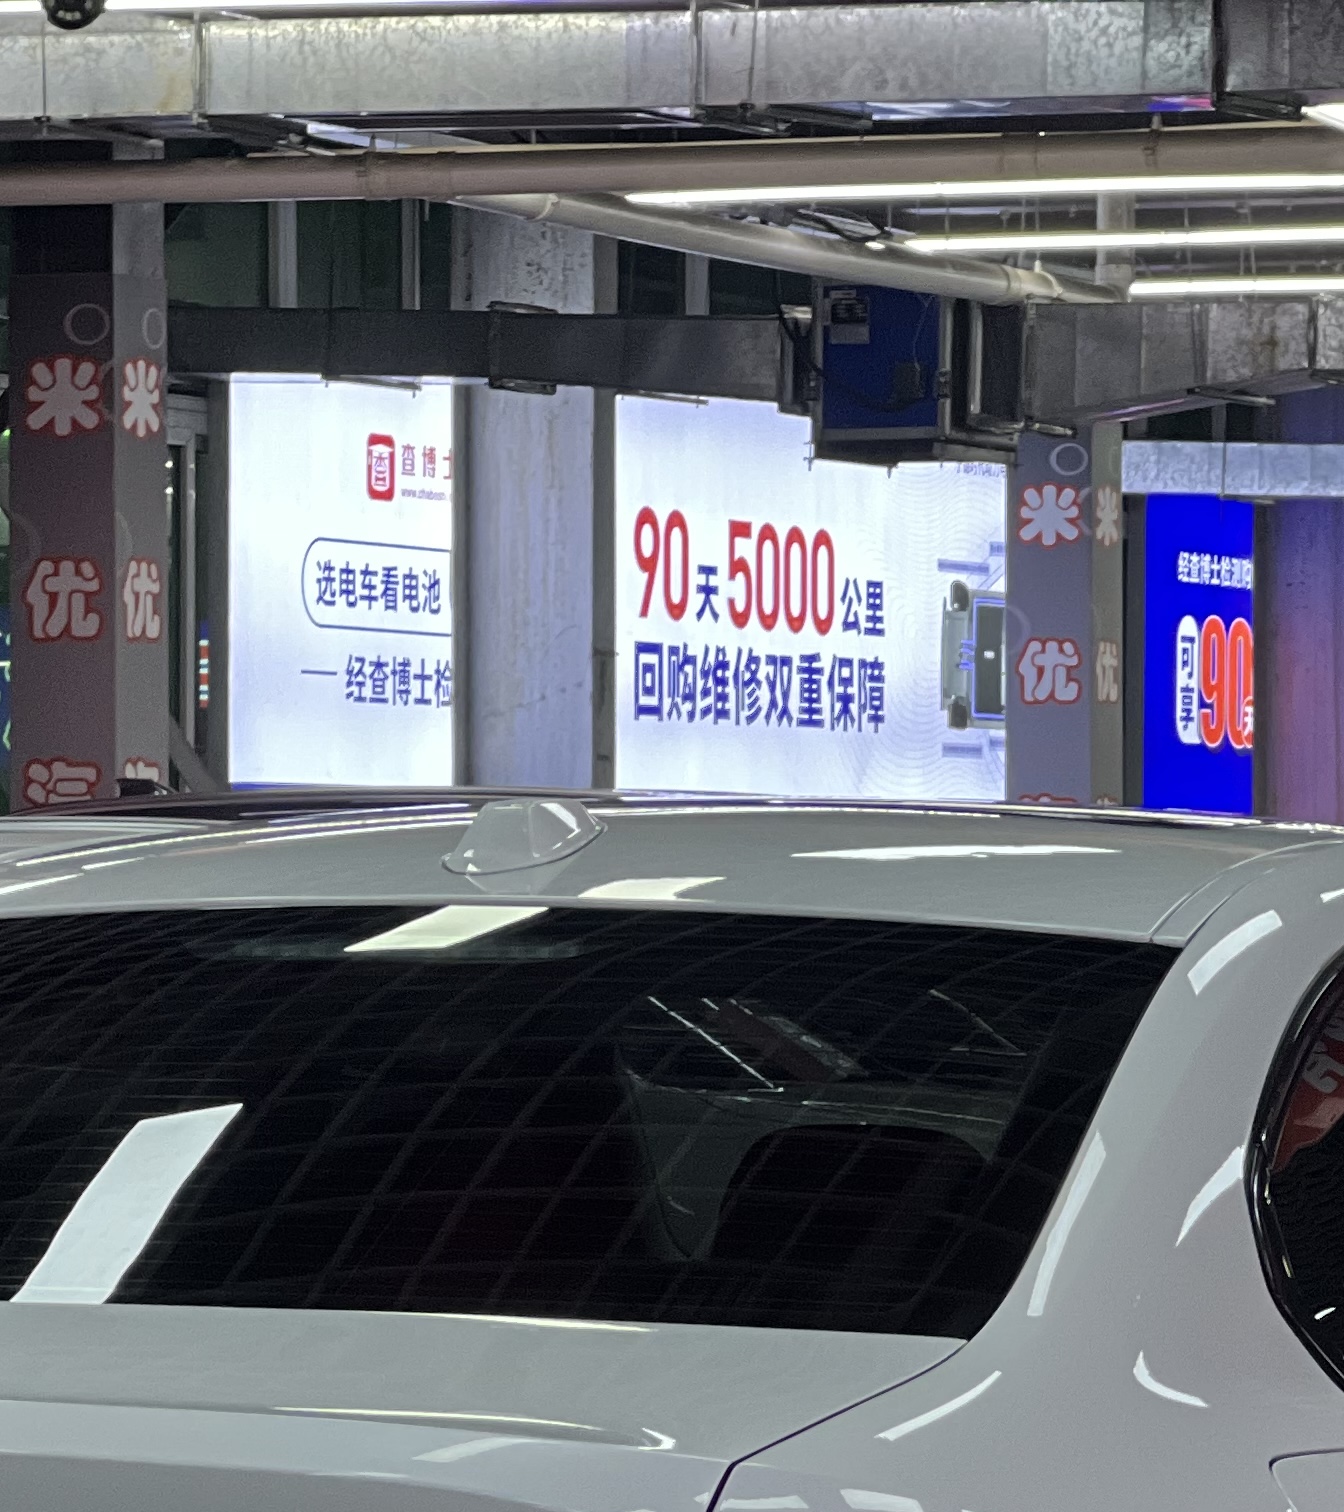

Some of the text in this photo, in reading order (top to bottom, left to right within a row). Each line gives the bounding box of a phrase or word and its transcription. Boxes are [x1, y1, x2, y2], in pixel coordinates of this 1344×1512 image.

[315, 558, 442, 615] 选电车看电池
[633, 641, 886, 733] 回购维修双重保障
